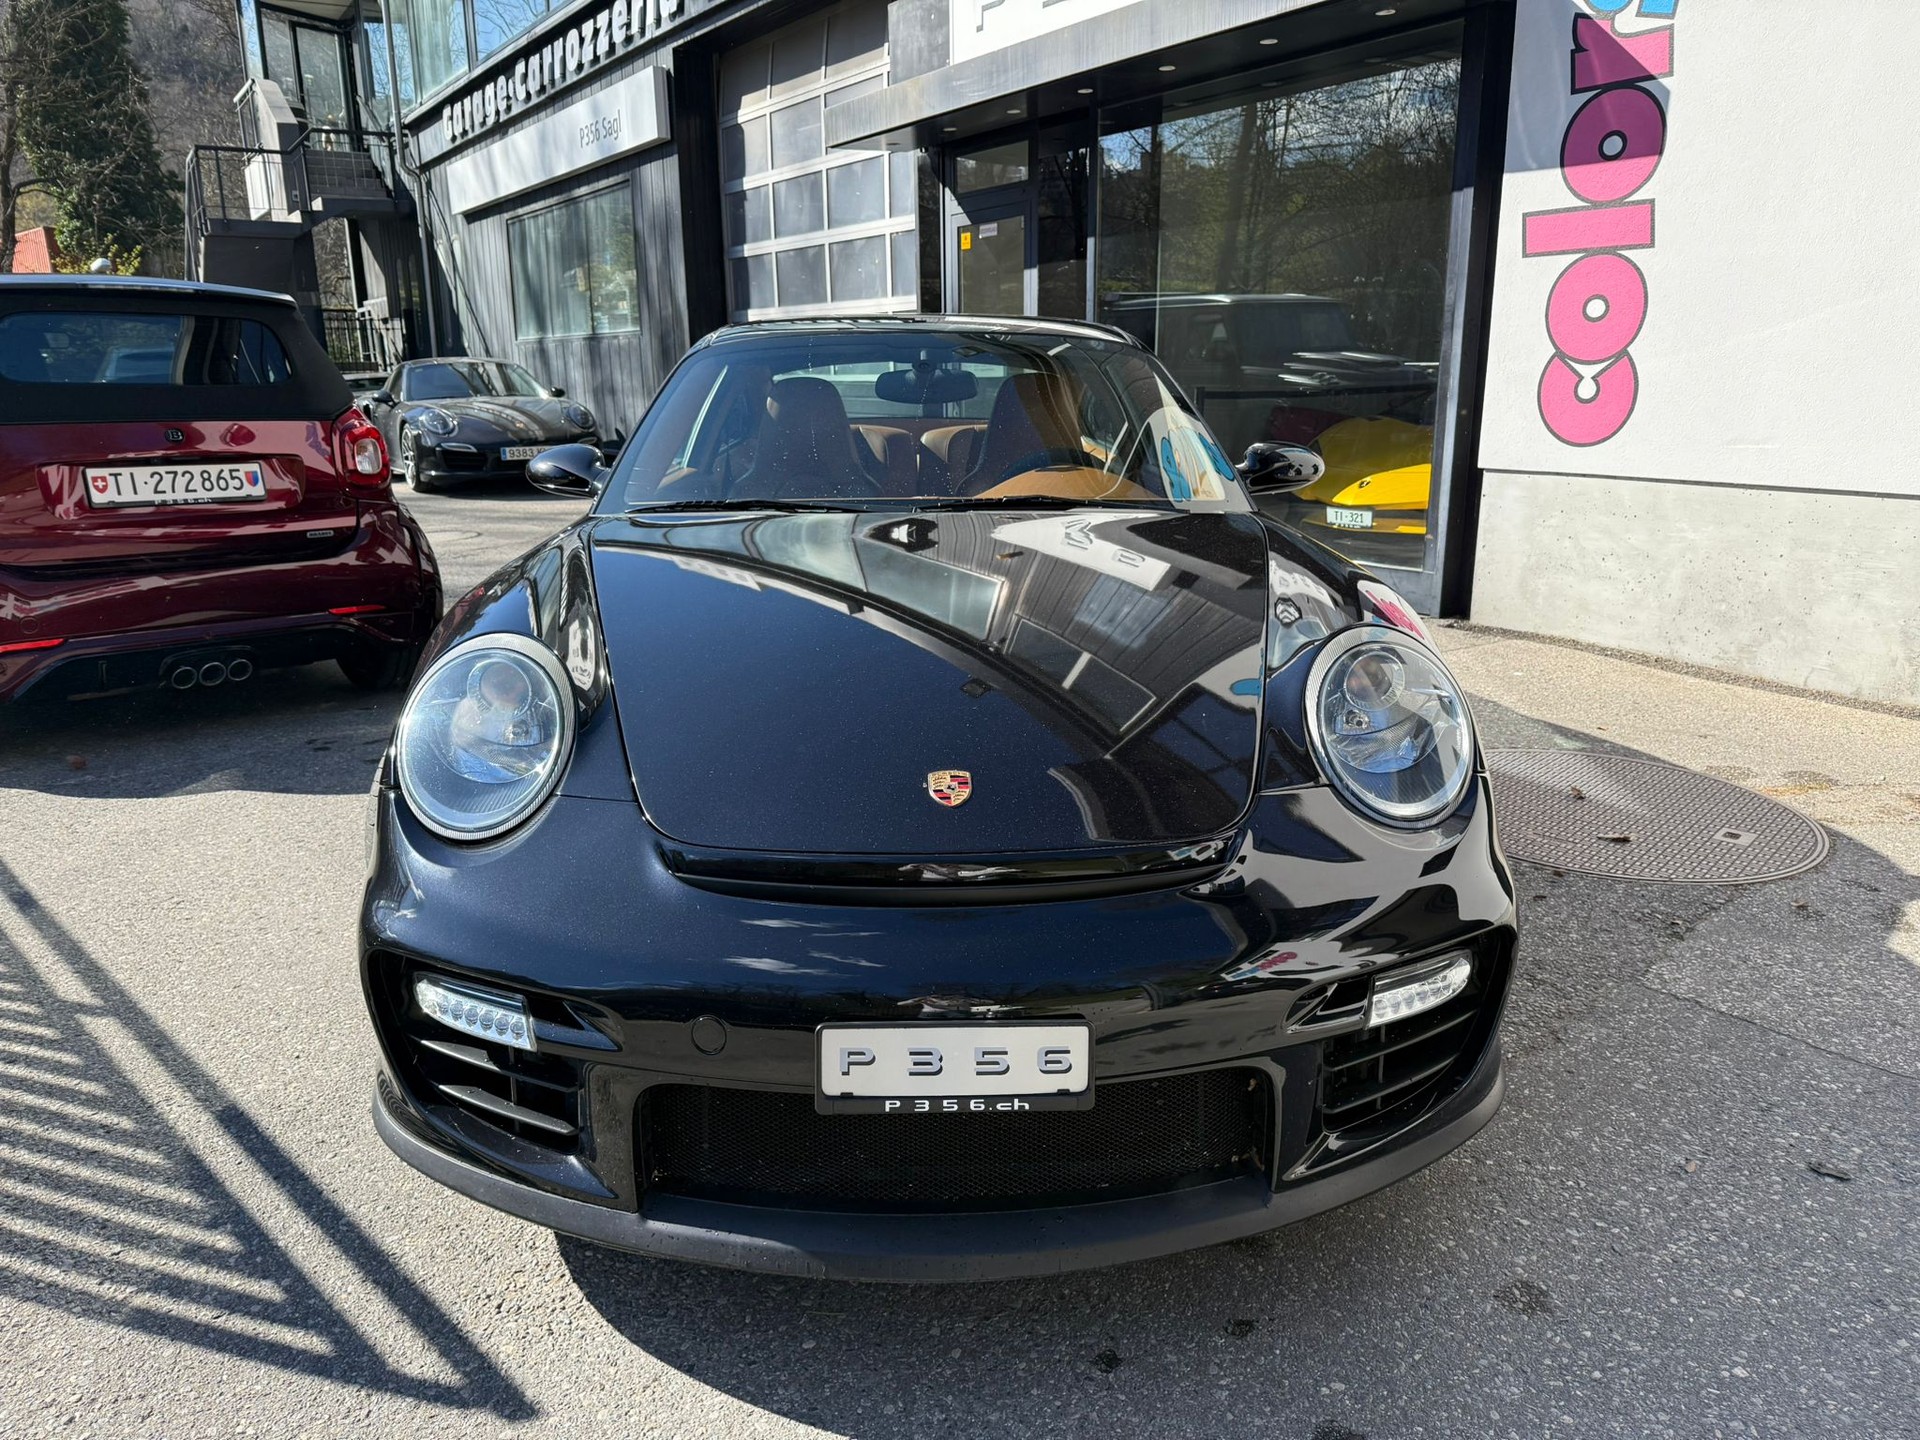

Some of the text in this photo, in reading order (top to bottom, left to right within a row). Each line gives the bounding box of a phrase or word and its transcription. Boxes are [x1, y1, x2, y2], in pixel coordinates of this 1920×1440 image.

[579, 120, 601, 148] P356
[1522, 0, 1680, 447] color
[509, 448, 535, 458] 9383
